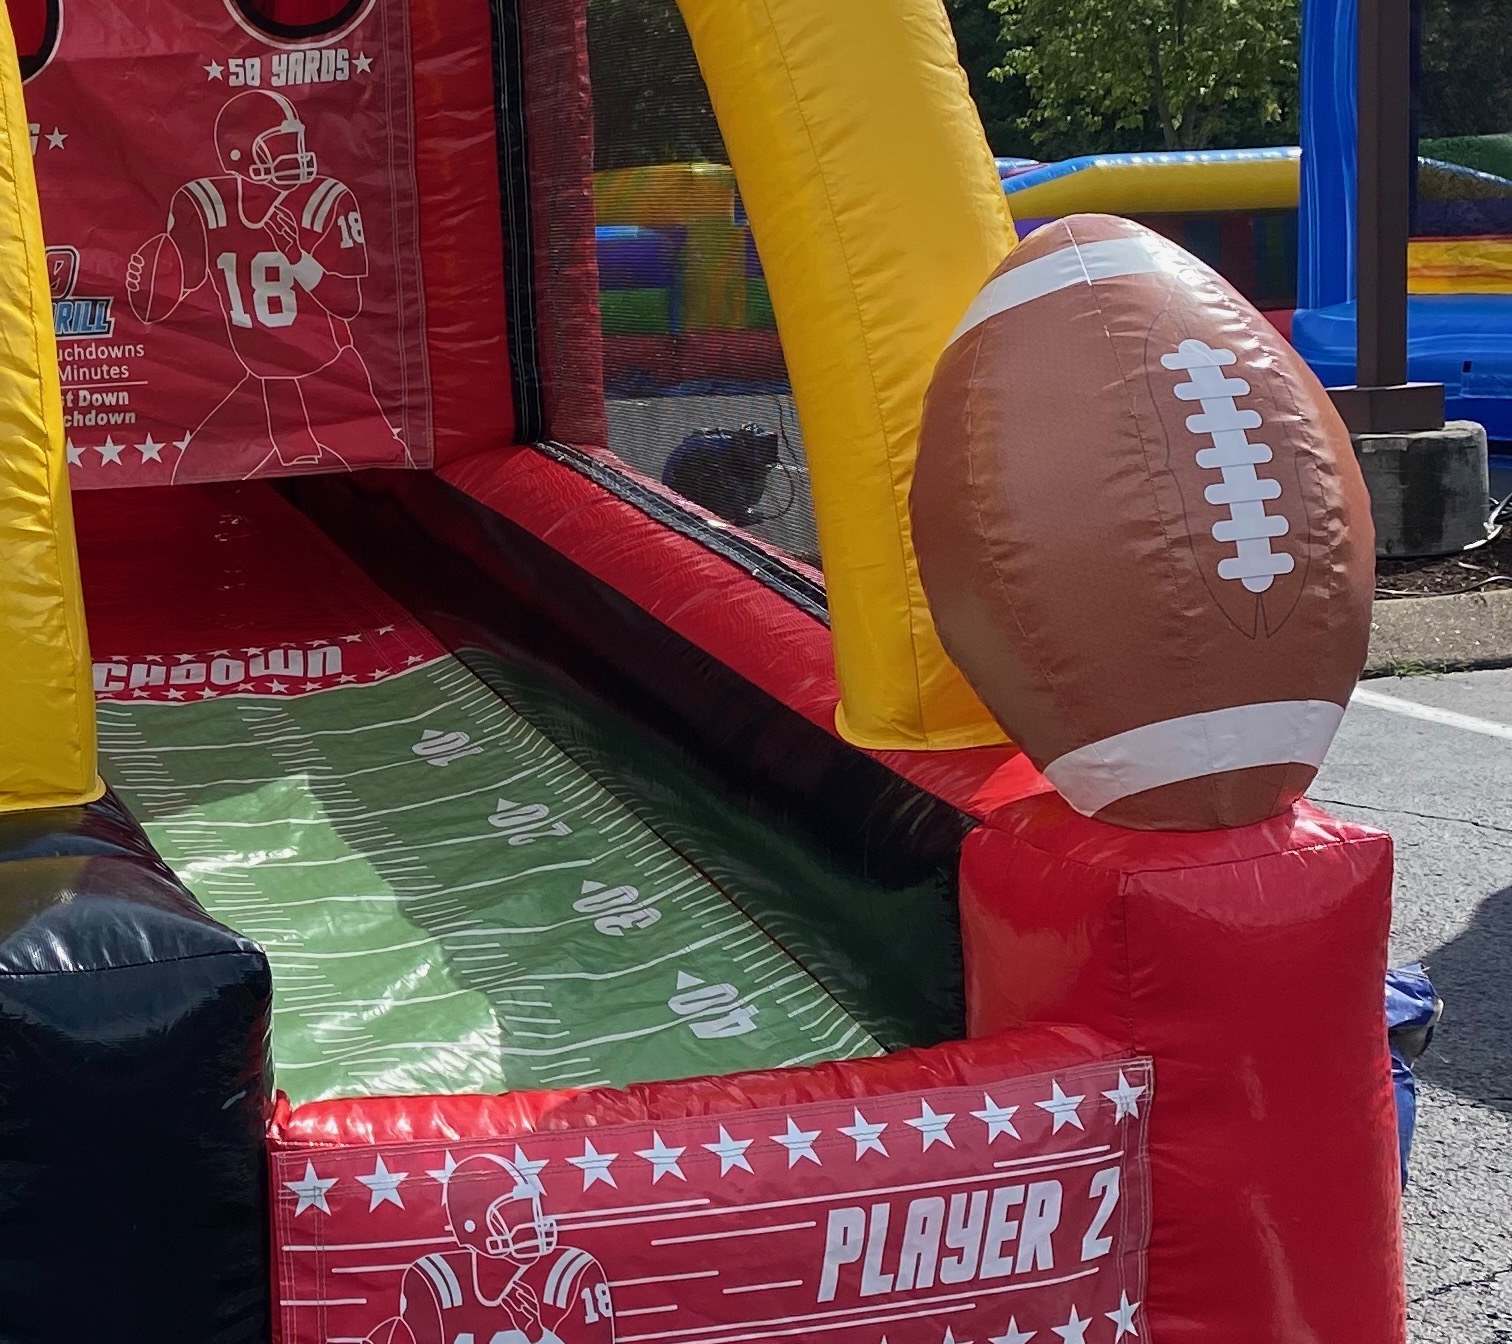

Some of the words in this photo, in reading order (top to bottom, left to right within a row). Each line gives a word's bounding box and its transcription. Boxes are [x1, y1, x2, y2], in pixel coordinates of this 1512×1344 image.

[228, 57, 261, 86] 50
[271, 49, 351, 85] YARDS
[337, 211, 364, 249] 18
[216, 251, 298, 328] 18
[51, 301, 108, 334] RILL
[57, 342, 145, 362] uchdowns
[58, 364, 129, 382] Minutes
[78, 389, 129, 407] Down
[63, 410, 136, 428] chdown
[92, 645, 343, 692] CHDOWN
[412, 731, 484, 767] 10
[488, 803, 573, 846] 20
[572, 885, 662, 937] 30
[667, 983, 760, 1040] 40
[818, 1178, 1065, 1303] PLAYER
[1081, 1166, 1121, 1263] 2
[582, 1282, 615, 1323] 18
